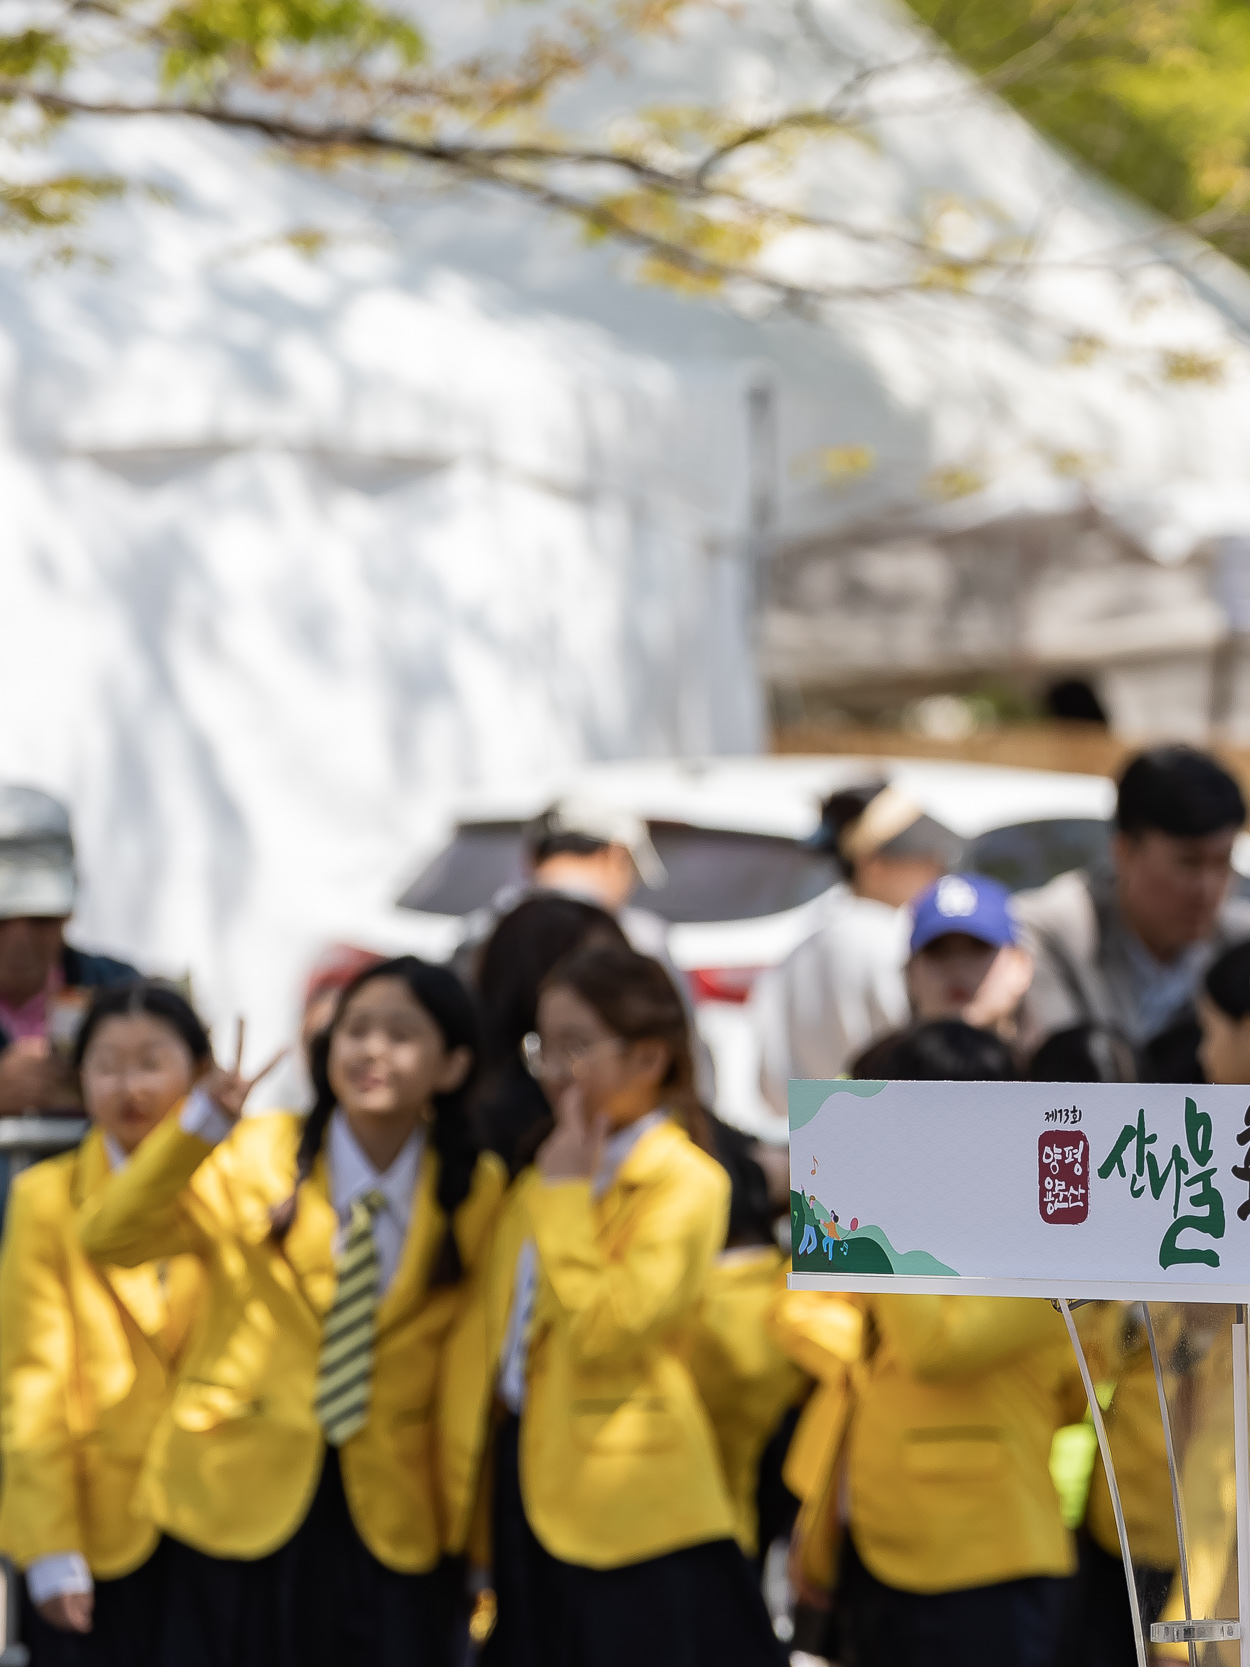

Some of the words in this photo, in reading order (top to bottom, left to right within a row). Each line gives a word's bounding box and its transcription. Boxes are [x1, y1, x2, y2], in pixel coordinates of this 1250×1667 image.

[1044, 1105, 1082, 1125] 제13회
[1042, 1140, 1085, 1176] 양평
[1043, 1176, 1086, 1215] 용문산
[1097, 1096, 1226, 1270] 산나물
